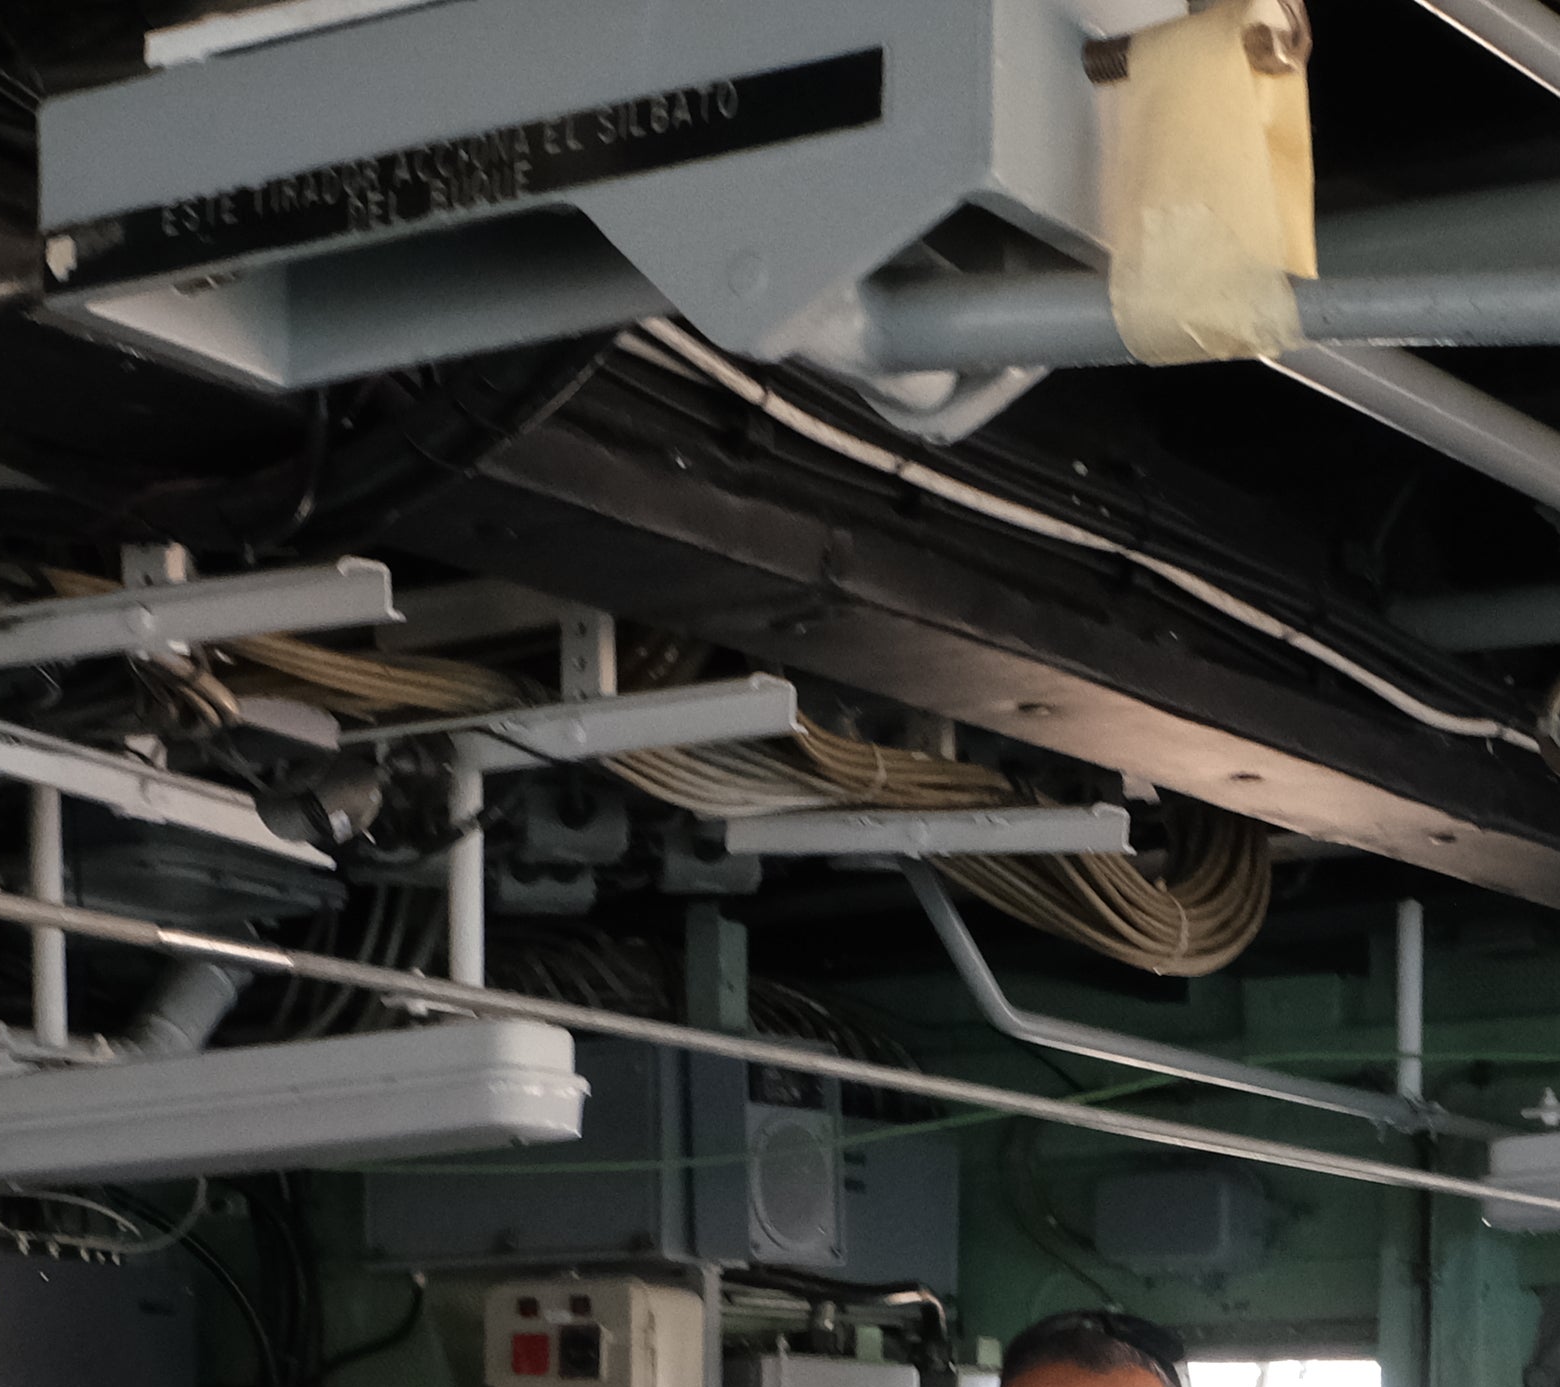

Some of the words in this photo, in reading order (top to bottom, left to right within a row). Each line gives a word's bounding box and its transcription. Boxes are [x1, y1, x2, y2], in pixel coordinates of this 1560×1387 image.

[160, 196, 241, 238] ESTE
[248, 160, 381, 218] TIRADOR
[392, 127, 531, 182] ACCIONA
[543, 119, 585, 155] EL
[594, 79, 739, 144] SILBATO
